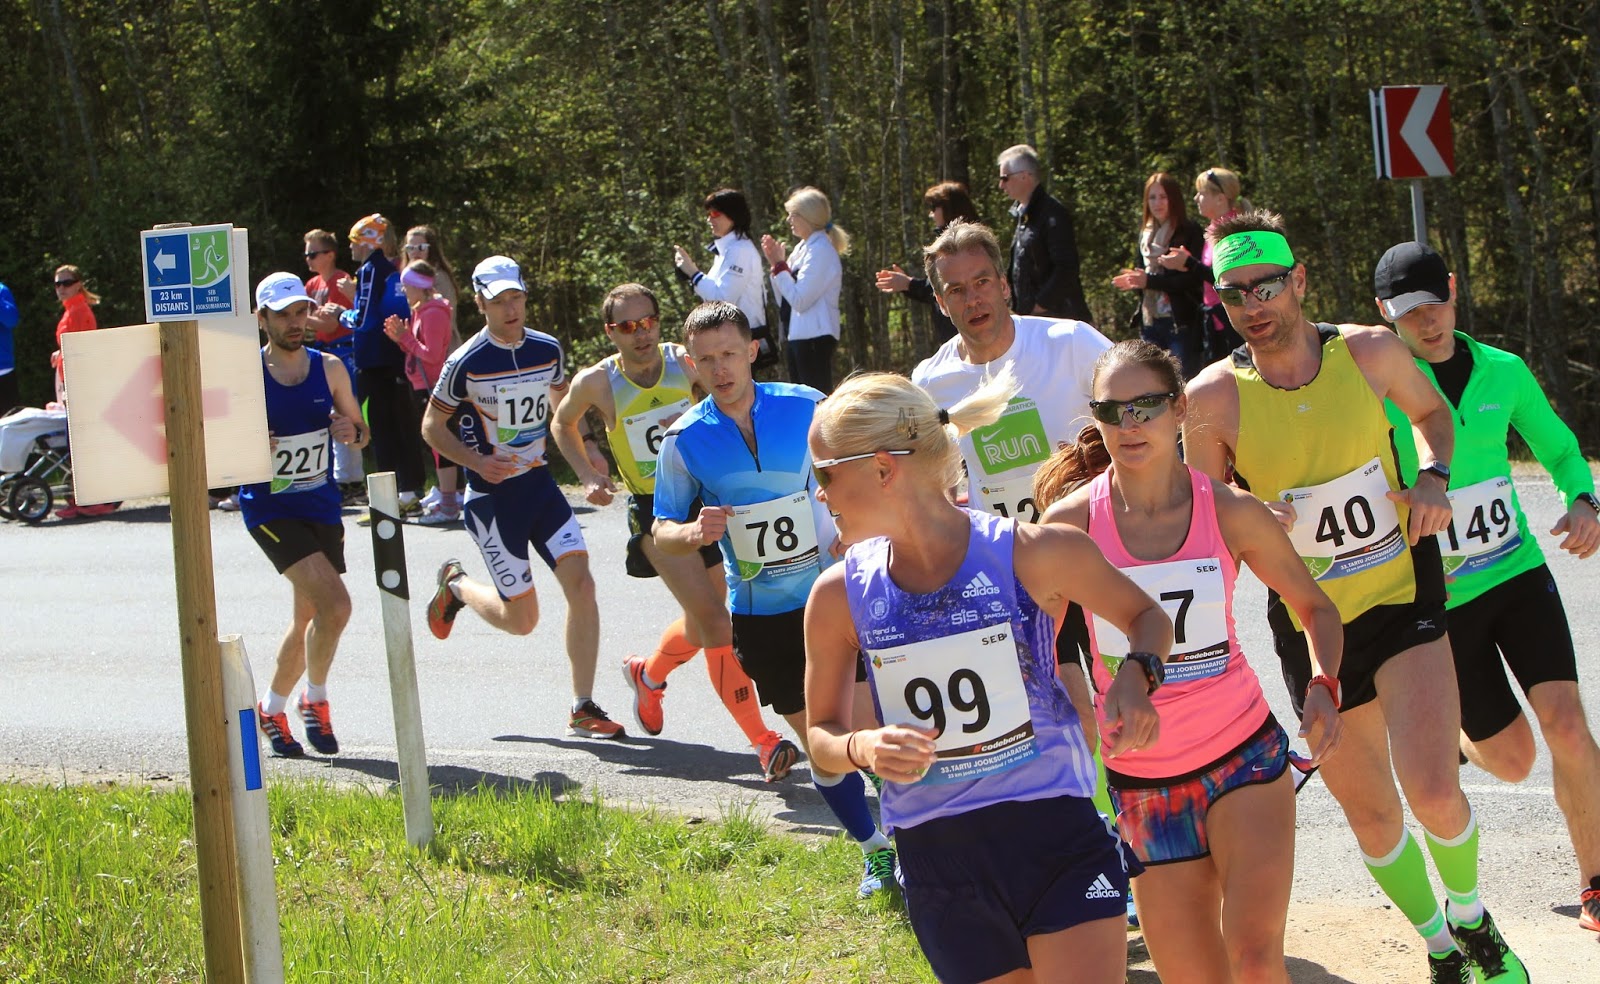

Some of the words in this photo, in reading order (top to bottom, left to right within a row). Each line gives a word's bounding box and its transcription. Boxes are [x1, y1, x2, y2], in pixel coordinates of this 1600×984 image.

[160, 291, 169, 301] 23
[171, 290, 182, 300] km
[155, 302, 189, 312] DISTANTS
[195, 302, 230, 310] JOOKSUMARATON
[505, 394, 546, 425] 126
[983, 433, 1041, 466] RUN
[276, 443, 325, 476] 227
[1364, 464, 1378, 477] SEB
[793, 495, 806, 504] SEB
[1315, 495, 1375, 548] 40
[1447, 498, 1511, 551] 149
[745, 516, 799, 557] 78
[483, 536, 517, 588] VALIO
[1196, 565, 1215, 573] SEB
[962, 585, 1000, 599] adidas
[981, 633, 1005, 646] SEB
[1184, 648, 1224, 661] codeborne
[904, 668, 991, 740] 99
[981, 731, 1027, 752] codeborne
[1085, 889, 1121, 900] adidas
